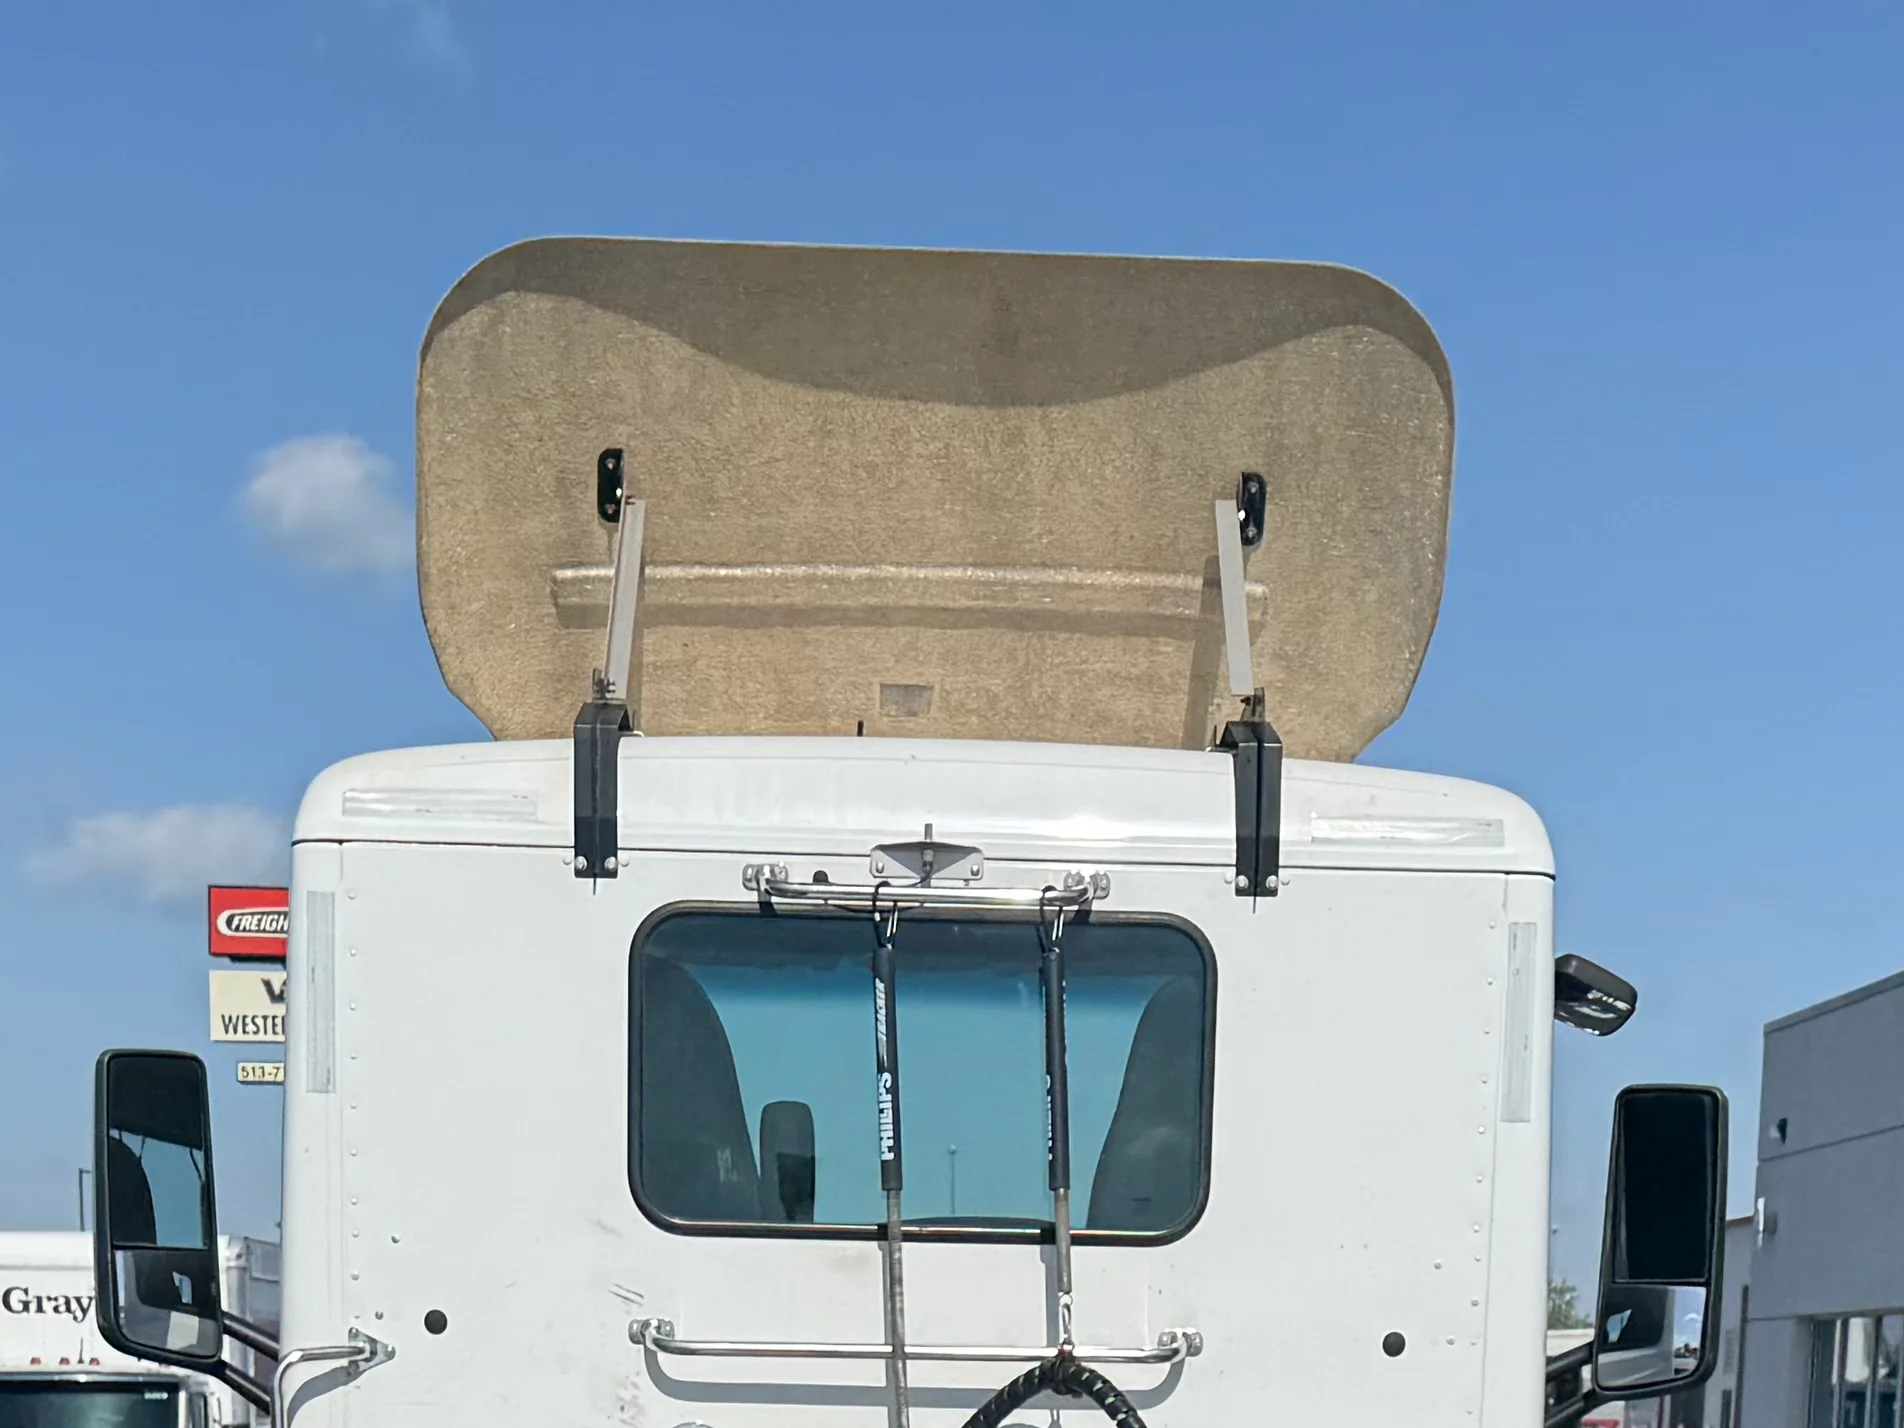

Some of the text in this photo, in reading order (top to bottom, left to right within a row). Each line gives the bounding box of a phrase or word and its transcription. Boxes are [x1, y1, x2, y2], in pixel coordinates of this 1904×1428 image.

[231, 914, 288, 932] FREIGH
[221, 1014, 285, 1036] WESTE
[1, 1286, 94, 1324] Gray
